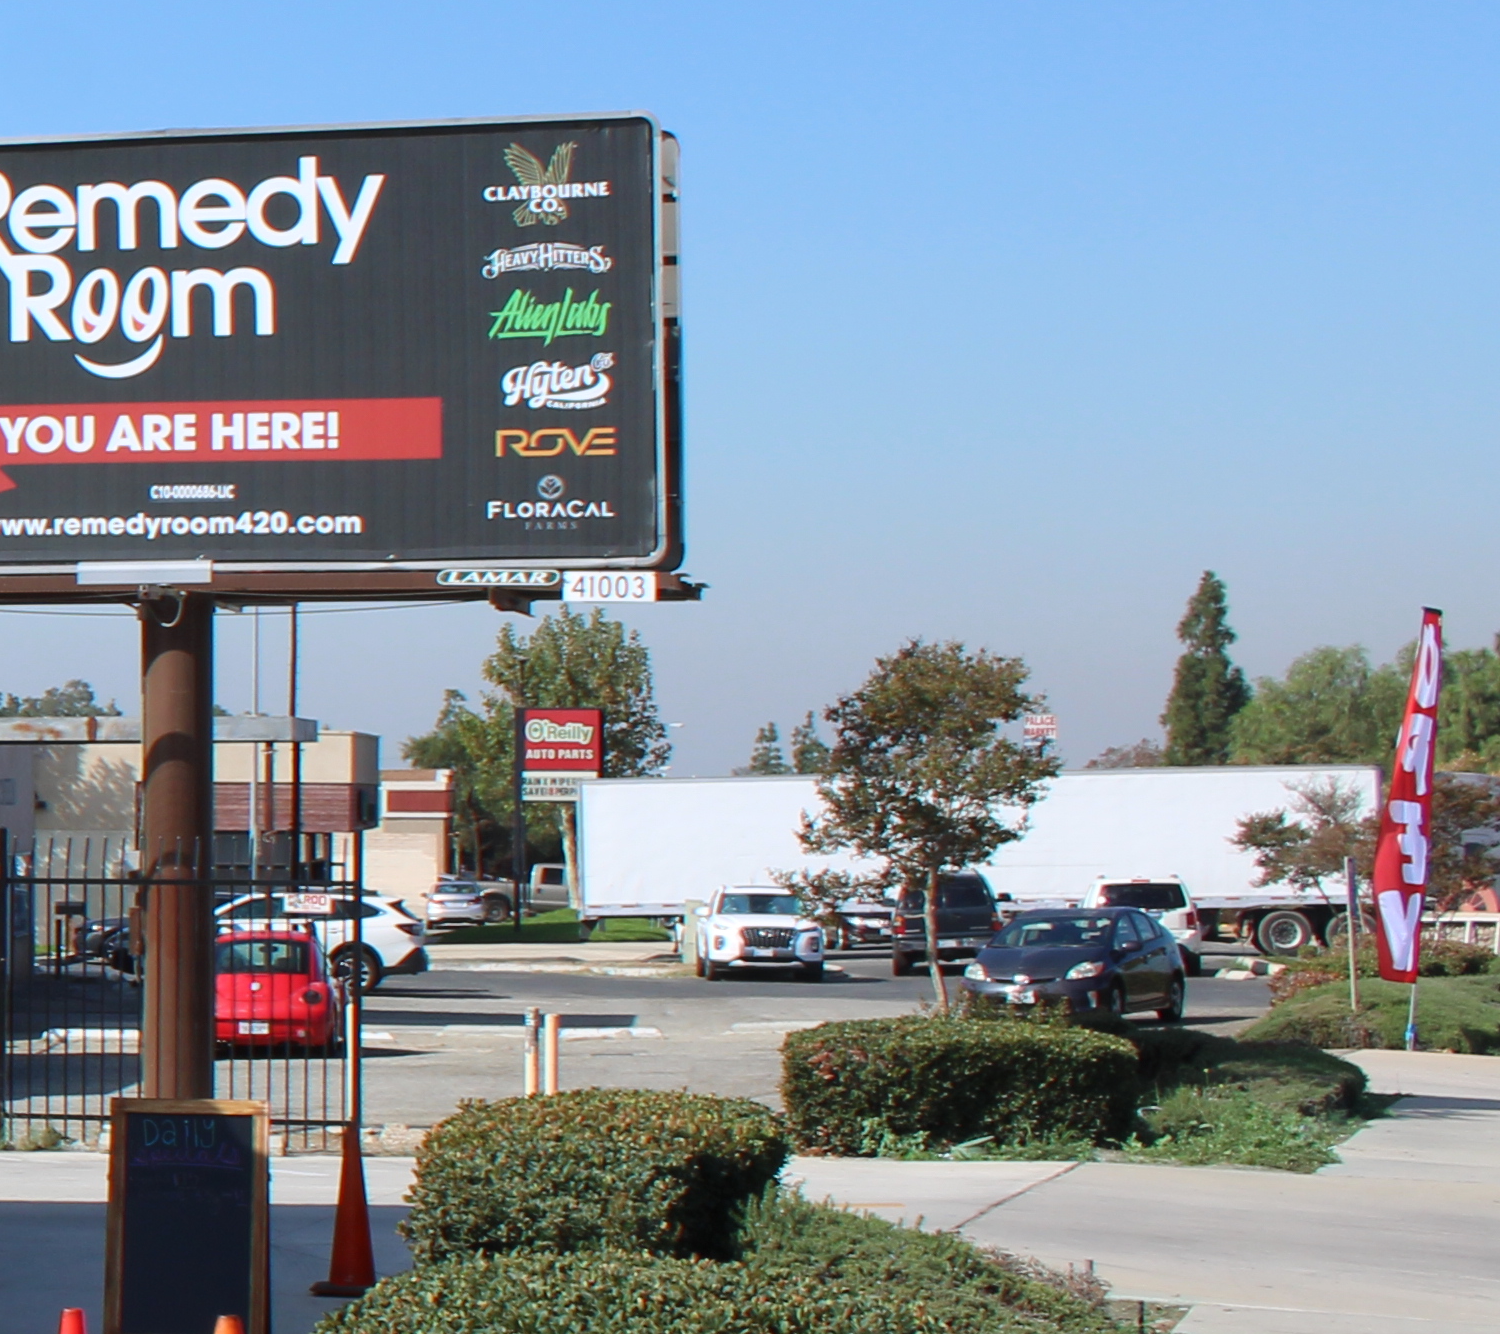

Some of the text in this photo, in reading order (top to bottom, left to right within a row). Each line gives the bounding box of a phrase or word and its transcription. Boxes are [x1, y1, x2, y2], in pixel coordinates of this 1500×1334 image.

[483, 181, 611, 201] CLAYBOURNE
[528, 199, 563, 213] CO.
[9, 254, 275, 344] Room
[501, 360, 611, 409] Hyten
[105, 414, 198, 453] ARE
[210, 411, 340, 451] HERE!
[495, 427, 617, 457] ROVE
[524, 521, 579, 531] FARMS
[447, 570, 550, 584] LAMAR
[571, 575, 646, 599] 41003
[525, 718, 594, 744] O'Reilly
[525, 748, 594, 760] AUTO PARTS
[142, 1118, 216, 1148] Daily
